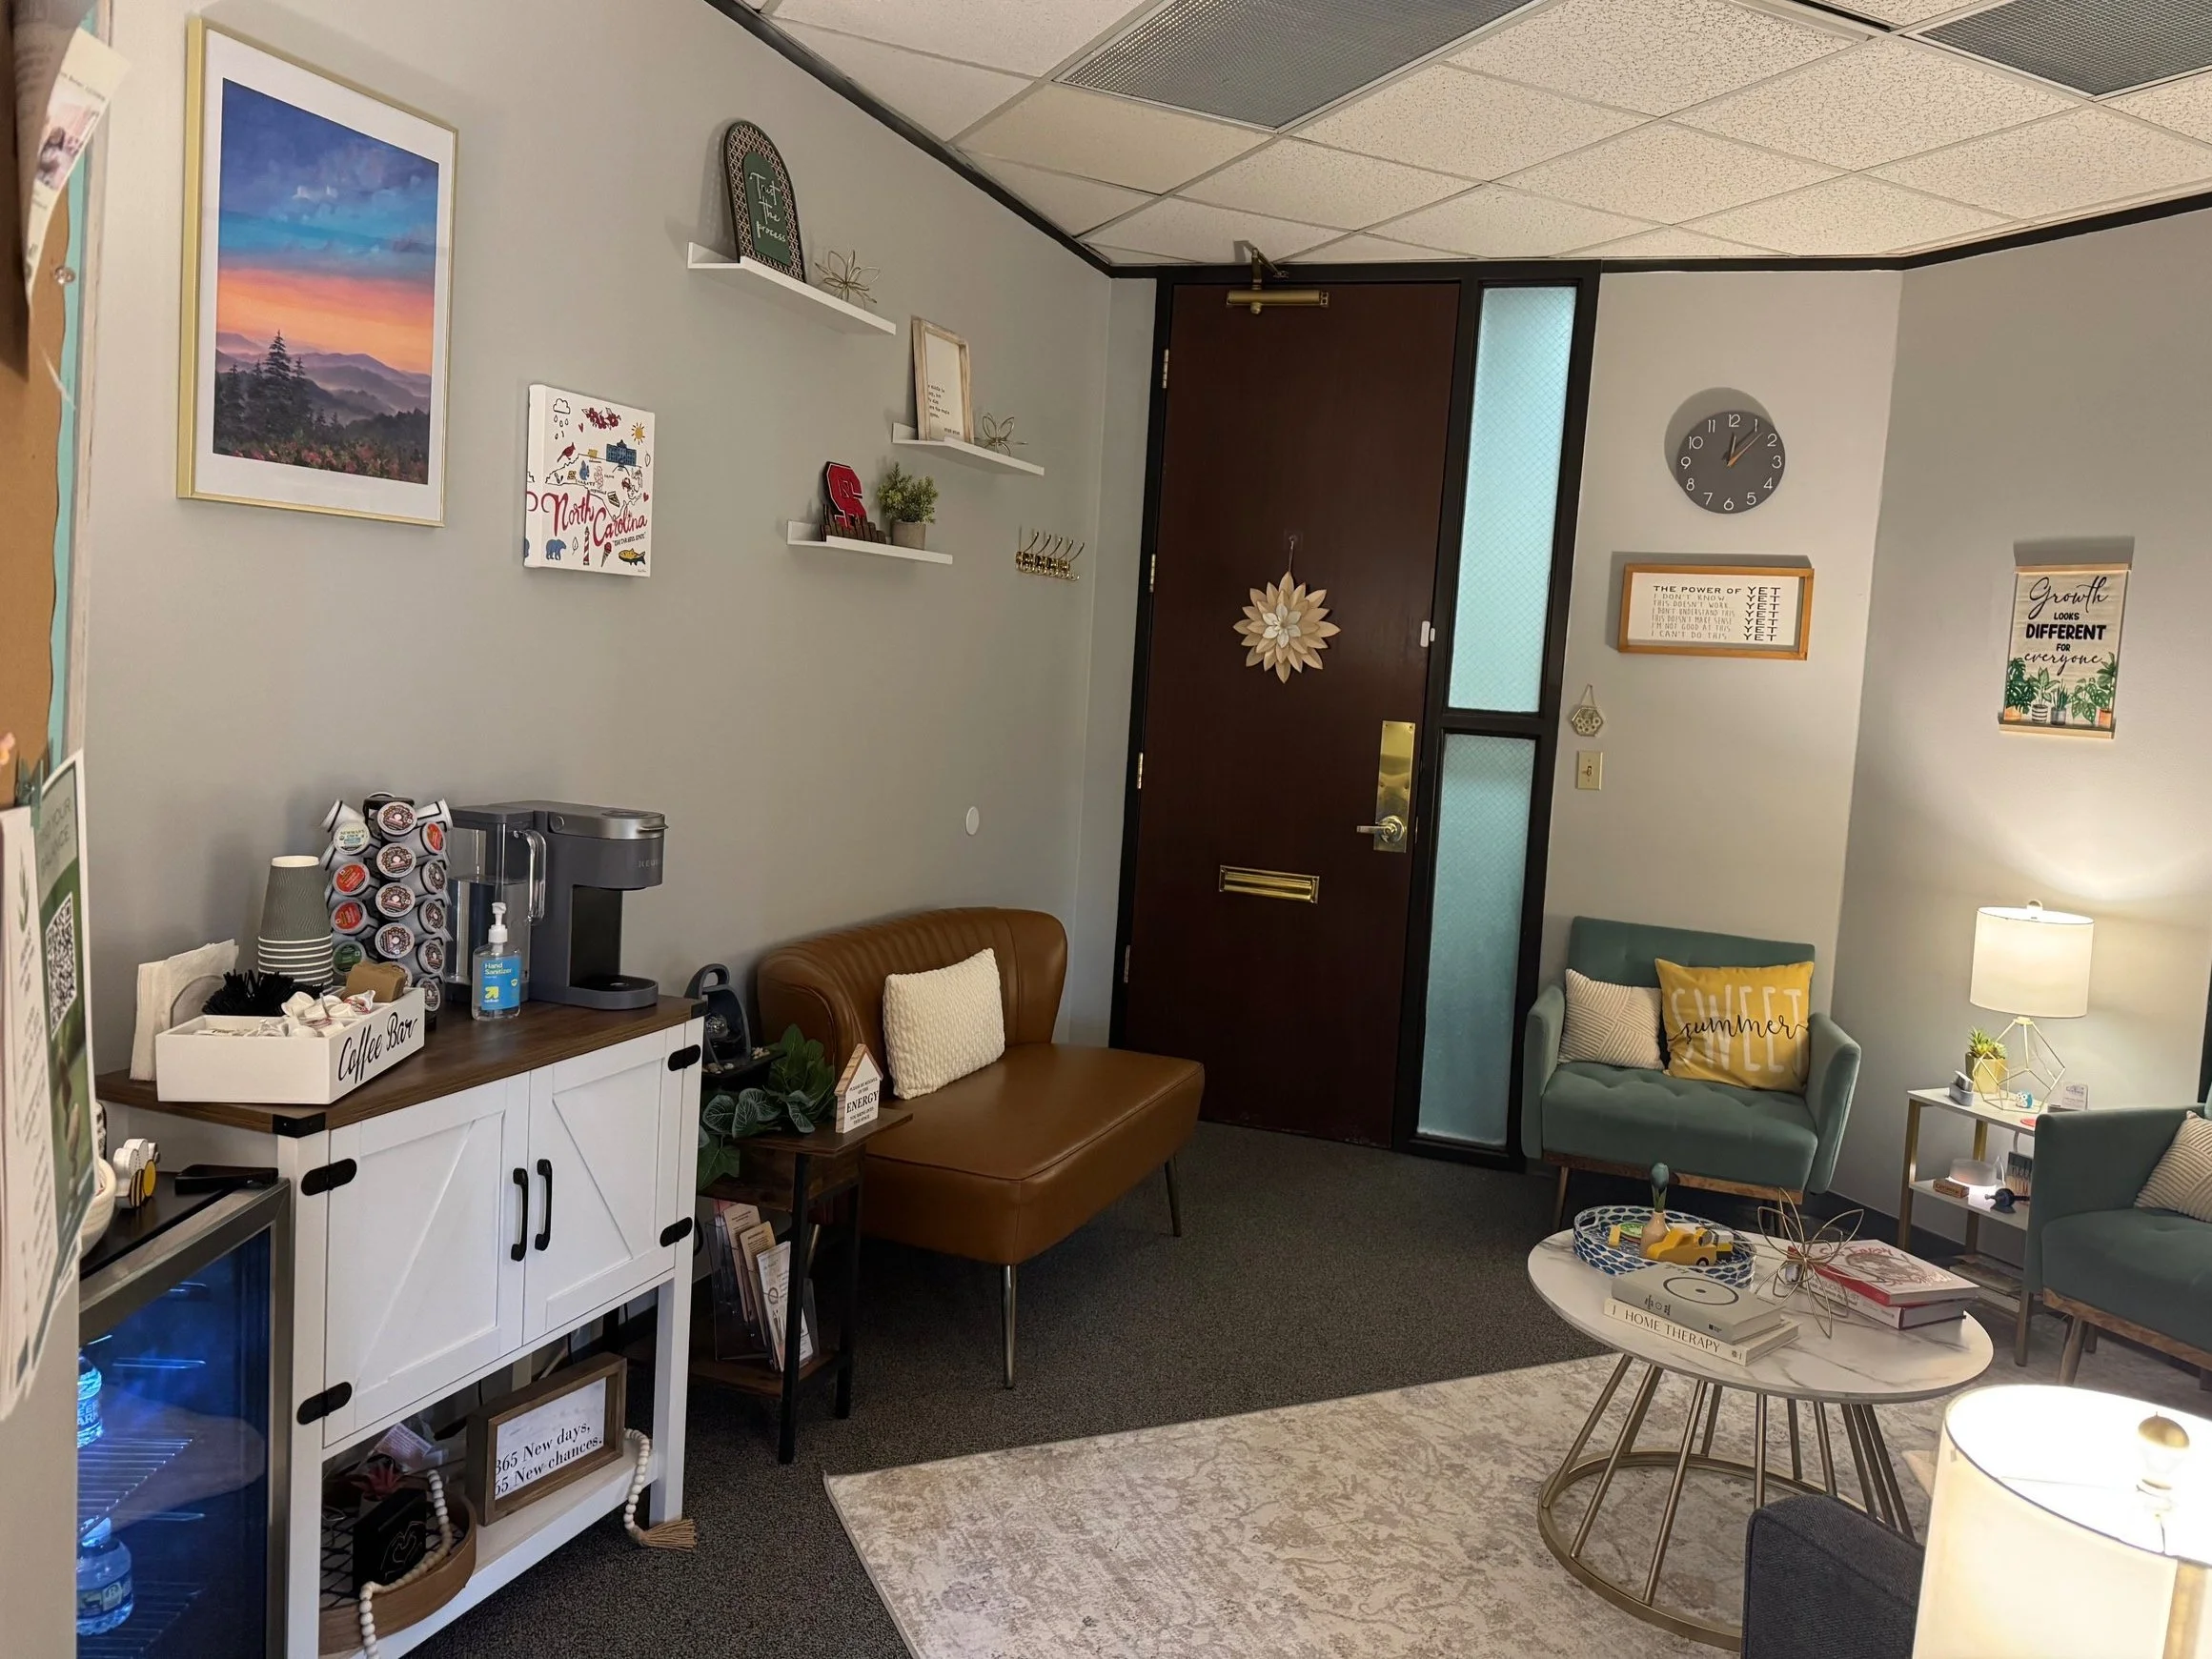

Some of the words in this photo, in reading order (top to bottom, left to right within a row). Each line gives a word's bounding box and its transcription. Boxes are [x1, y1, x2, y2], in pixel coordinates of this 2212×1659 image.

[749, 172, 781, 205] Trust
[758, 196, 781, 224] the
[756, 220, 786, 242] process
[1708, 419, 1715, 434] 11
[1728, 414, 1740, 428] 12
[1755, 418, 1758, 433] 1
[1689, 435, 1704, 450] 10
[1767, 433, 1777, 447] 2
[1680, 455, 1692, 470] 9
[1772, 455, 1782, 469] 3
[1686, 477, 1695, 492] 8
[1763, 476, 1774, 491] 4
[1703, 492, 1714, 506] 7
[1723, 497, 1735, 511] 6
[1746, 492, 1756, 506] 5
[541, 487, 595, 536] North
[593, 505, 648, 547] Carolina
[1747, 586, 1781, 595] YET
[2028, 576, 2109, 620] Growth
[1746, 595, 1780, 603] YET
[1746, 602, 1780, 611] YET
[1744, 617, 1778, 626] YET
[1745, 610, 1779, 618] YET
[2054, 612, 2080, 620] LOOKS
[1743, 625, 1777, 634] YET
[1743, 633, 1776, 641] YET
[2025, 624, 2107, 640] DIFFERENT
[2056, 643, 2071, 652] FOR
[2024, 652, 2102, 676] everyone
[1668, 1014, 1809, 1044] summer
[1671, 984, 1802, 1075] SWEET
[338, 1023, 382, 1083] Coffee
[386, 1011, 418, 1051] Bar
[846, 1091, 879, 1113] ENERGY
[1625, 1309, 1659, 1330] HOME
[1665, 1324, 1721, 1352] THERAPY
[496, 1451, 517, 1475] 365
[522, 1439, 553, 1462] New
[557, 1423, 591, 1445] days,
[495, 1476, 509, 1496] 65
[514, 1464, 544, 1487] New
[548, 1436, 602, 1469] chances.
